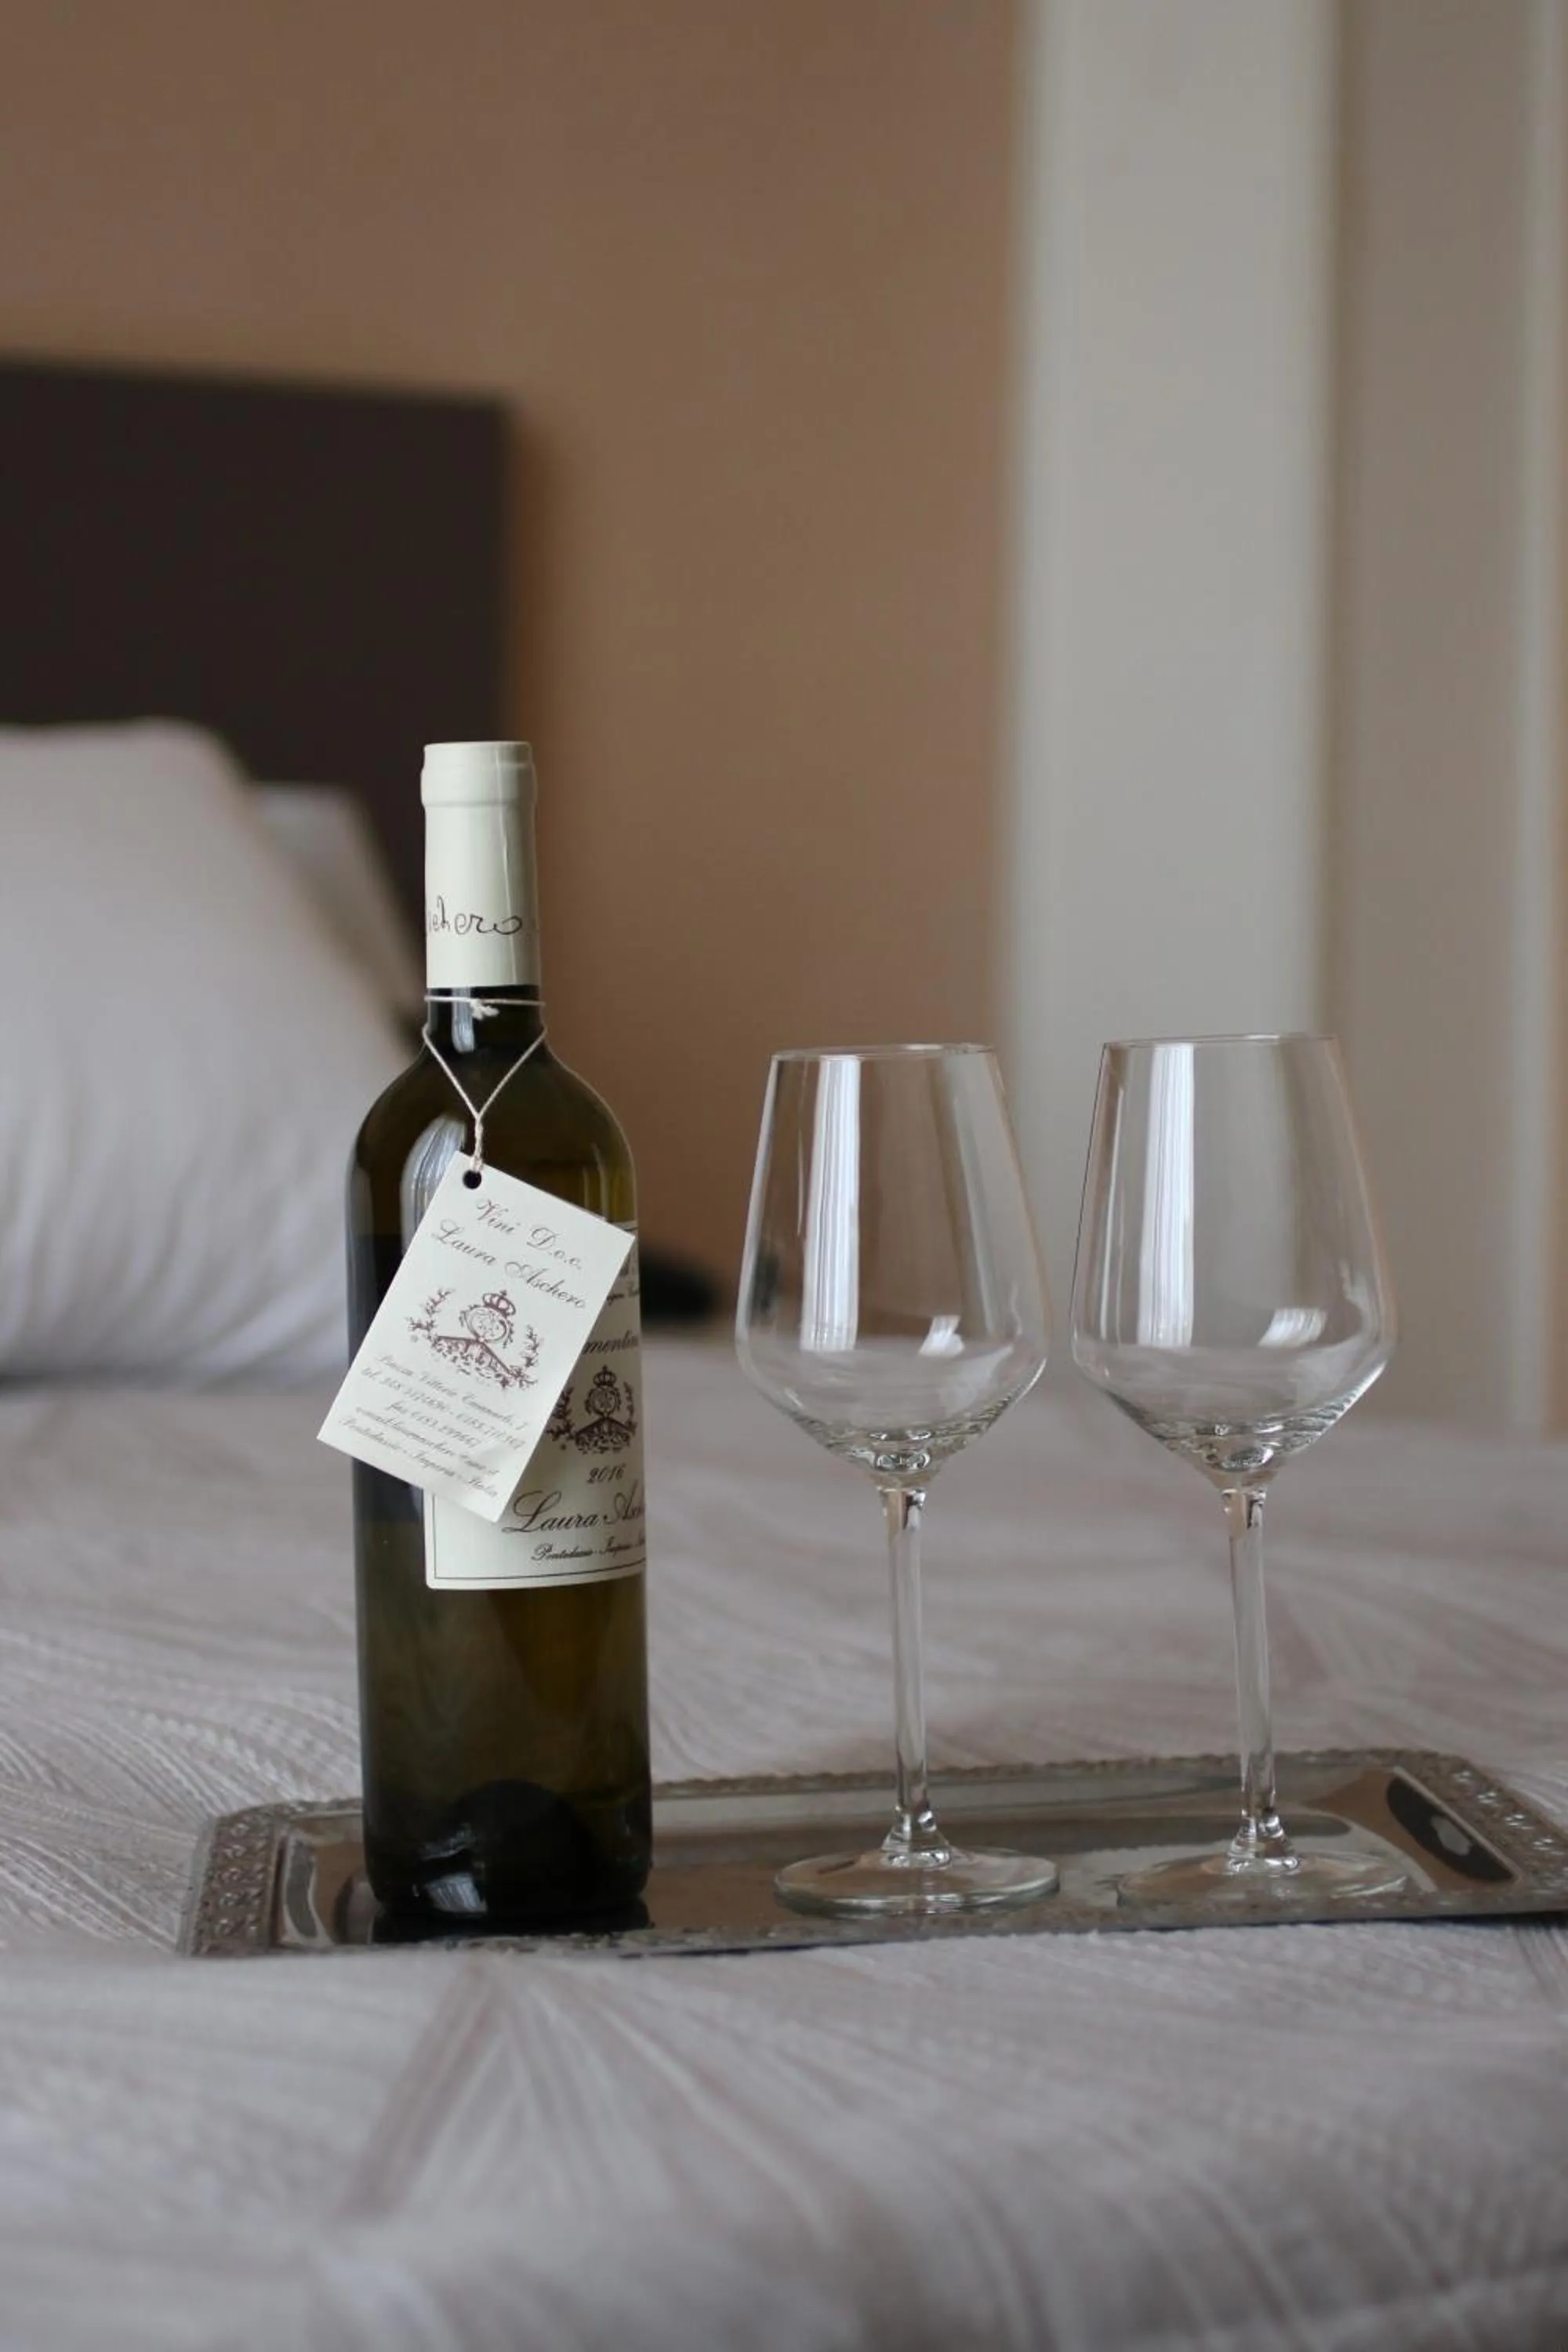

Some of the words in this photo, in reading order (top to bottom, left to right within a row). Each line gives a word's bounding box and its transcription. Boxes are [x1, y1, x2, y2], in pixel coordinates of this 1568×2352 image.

[477, 1199, 520, 1233] Vini
[432, 1219, 495, 1265] Laura
[504, 1261, 585, 1308] Aschero
[587, 1464, 626, 1484] 2016
[501, 1490, 599, 1533] Laura
